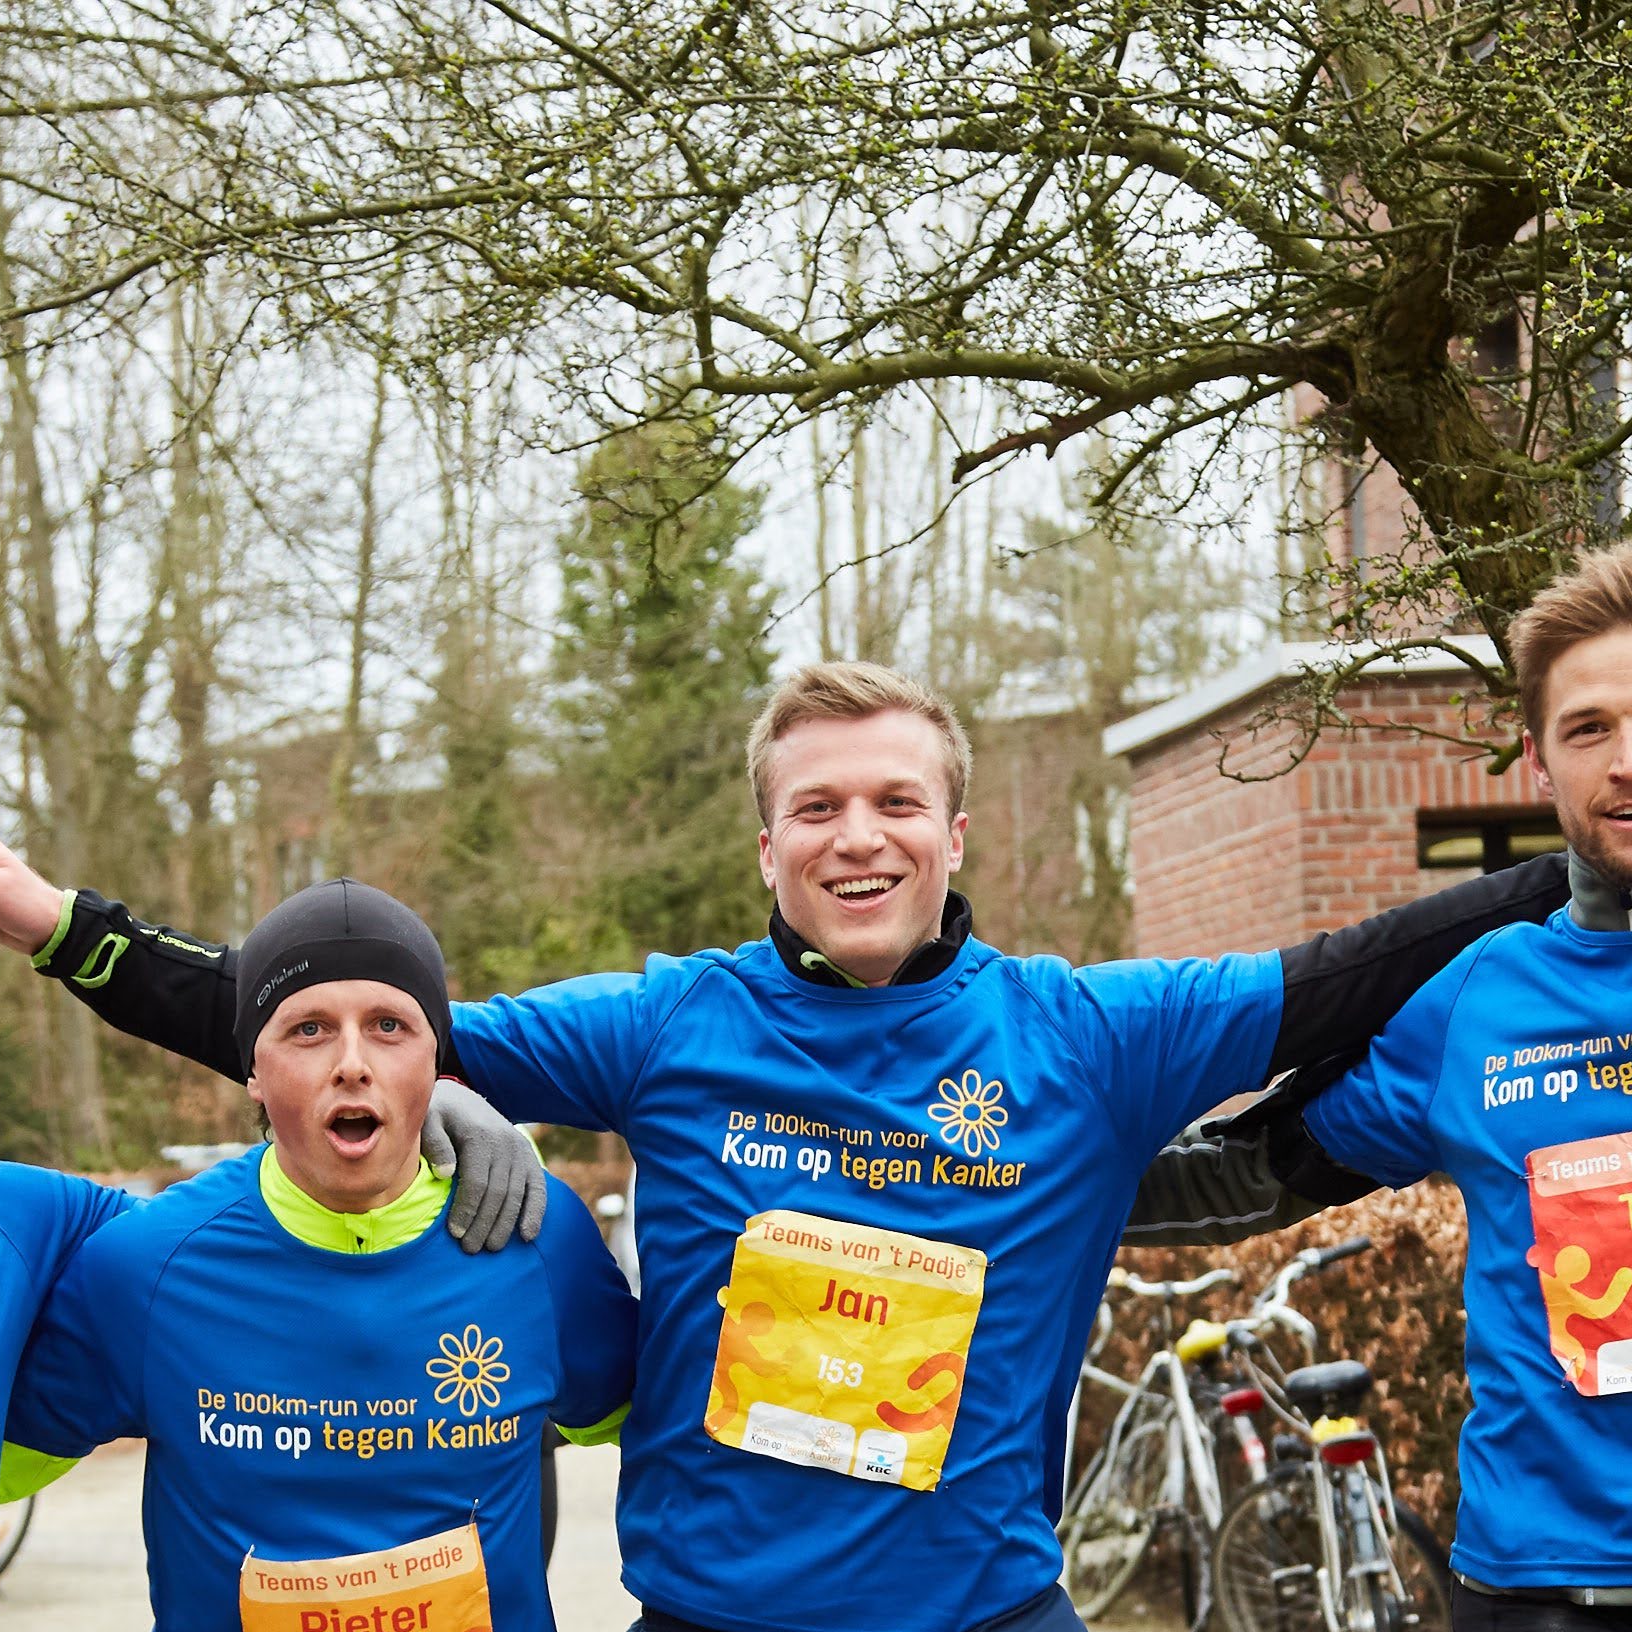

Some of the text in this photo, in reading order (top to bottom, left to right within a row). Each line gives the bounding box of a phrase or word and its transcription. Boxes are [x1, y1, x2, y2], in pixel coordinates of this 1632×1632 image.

[1484, 1053, 1507, 1076] De
[1512, 1036, 1613, 1069] 100km-run
[1483, 1073, 1535, 1111] Kom
[1543, 1068, 1579, 1103] op
[728, 1111, 930, 1150] De 100km-run voor
[721, 1132, 1027, 1191] Kom op tegen Kanker
[1547, 1153, 1622, 1182] Teams
[762, 1220, 834, 1252] Teams
[840, 1238, 881, 1262] van
[907, 1250, 968, 1281] Padje
[818, 1279, 889, 1326] Jan
[817, 1354, 865, 1388] 153
[198, 1388, 418, 1417] De 100km-run voor
[199, 1412, 520, 1460] Kom op tegen Kanker
[750, 1433, 769, 1449] Kom
[866, 1463, 892, 1476] KBC
[255, 1571, 329, 1591] Teams
[336, 1568, 377, 1588] van
[405, 1545, 464, 1577] Padje
